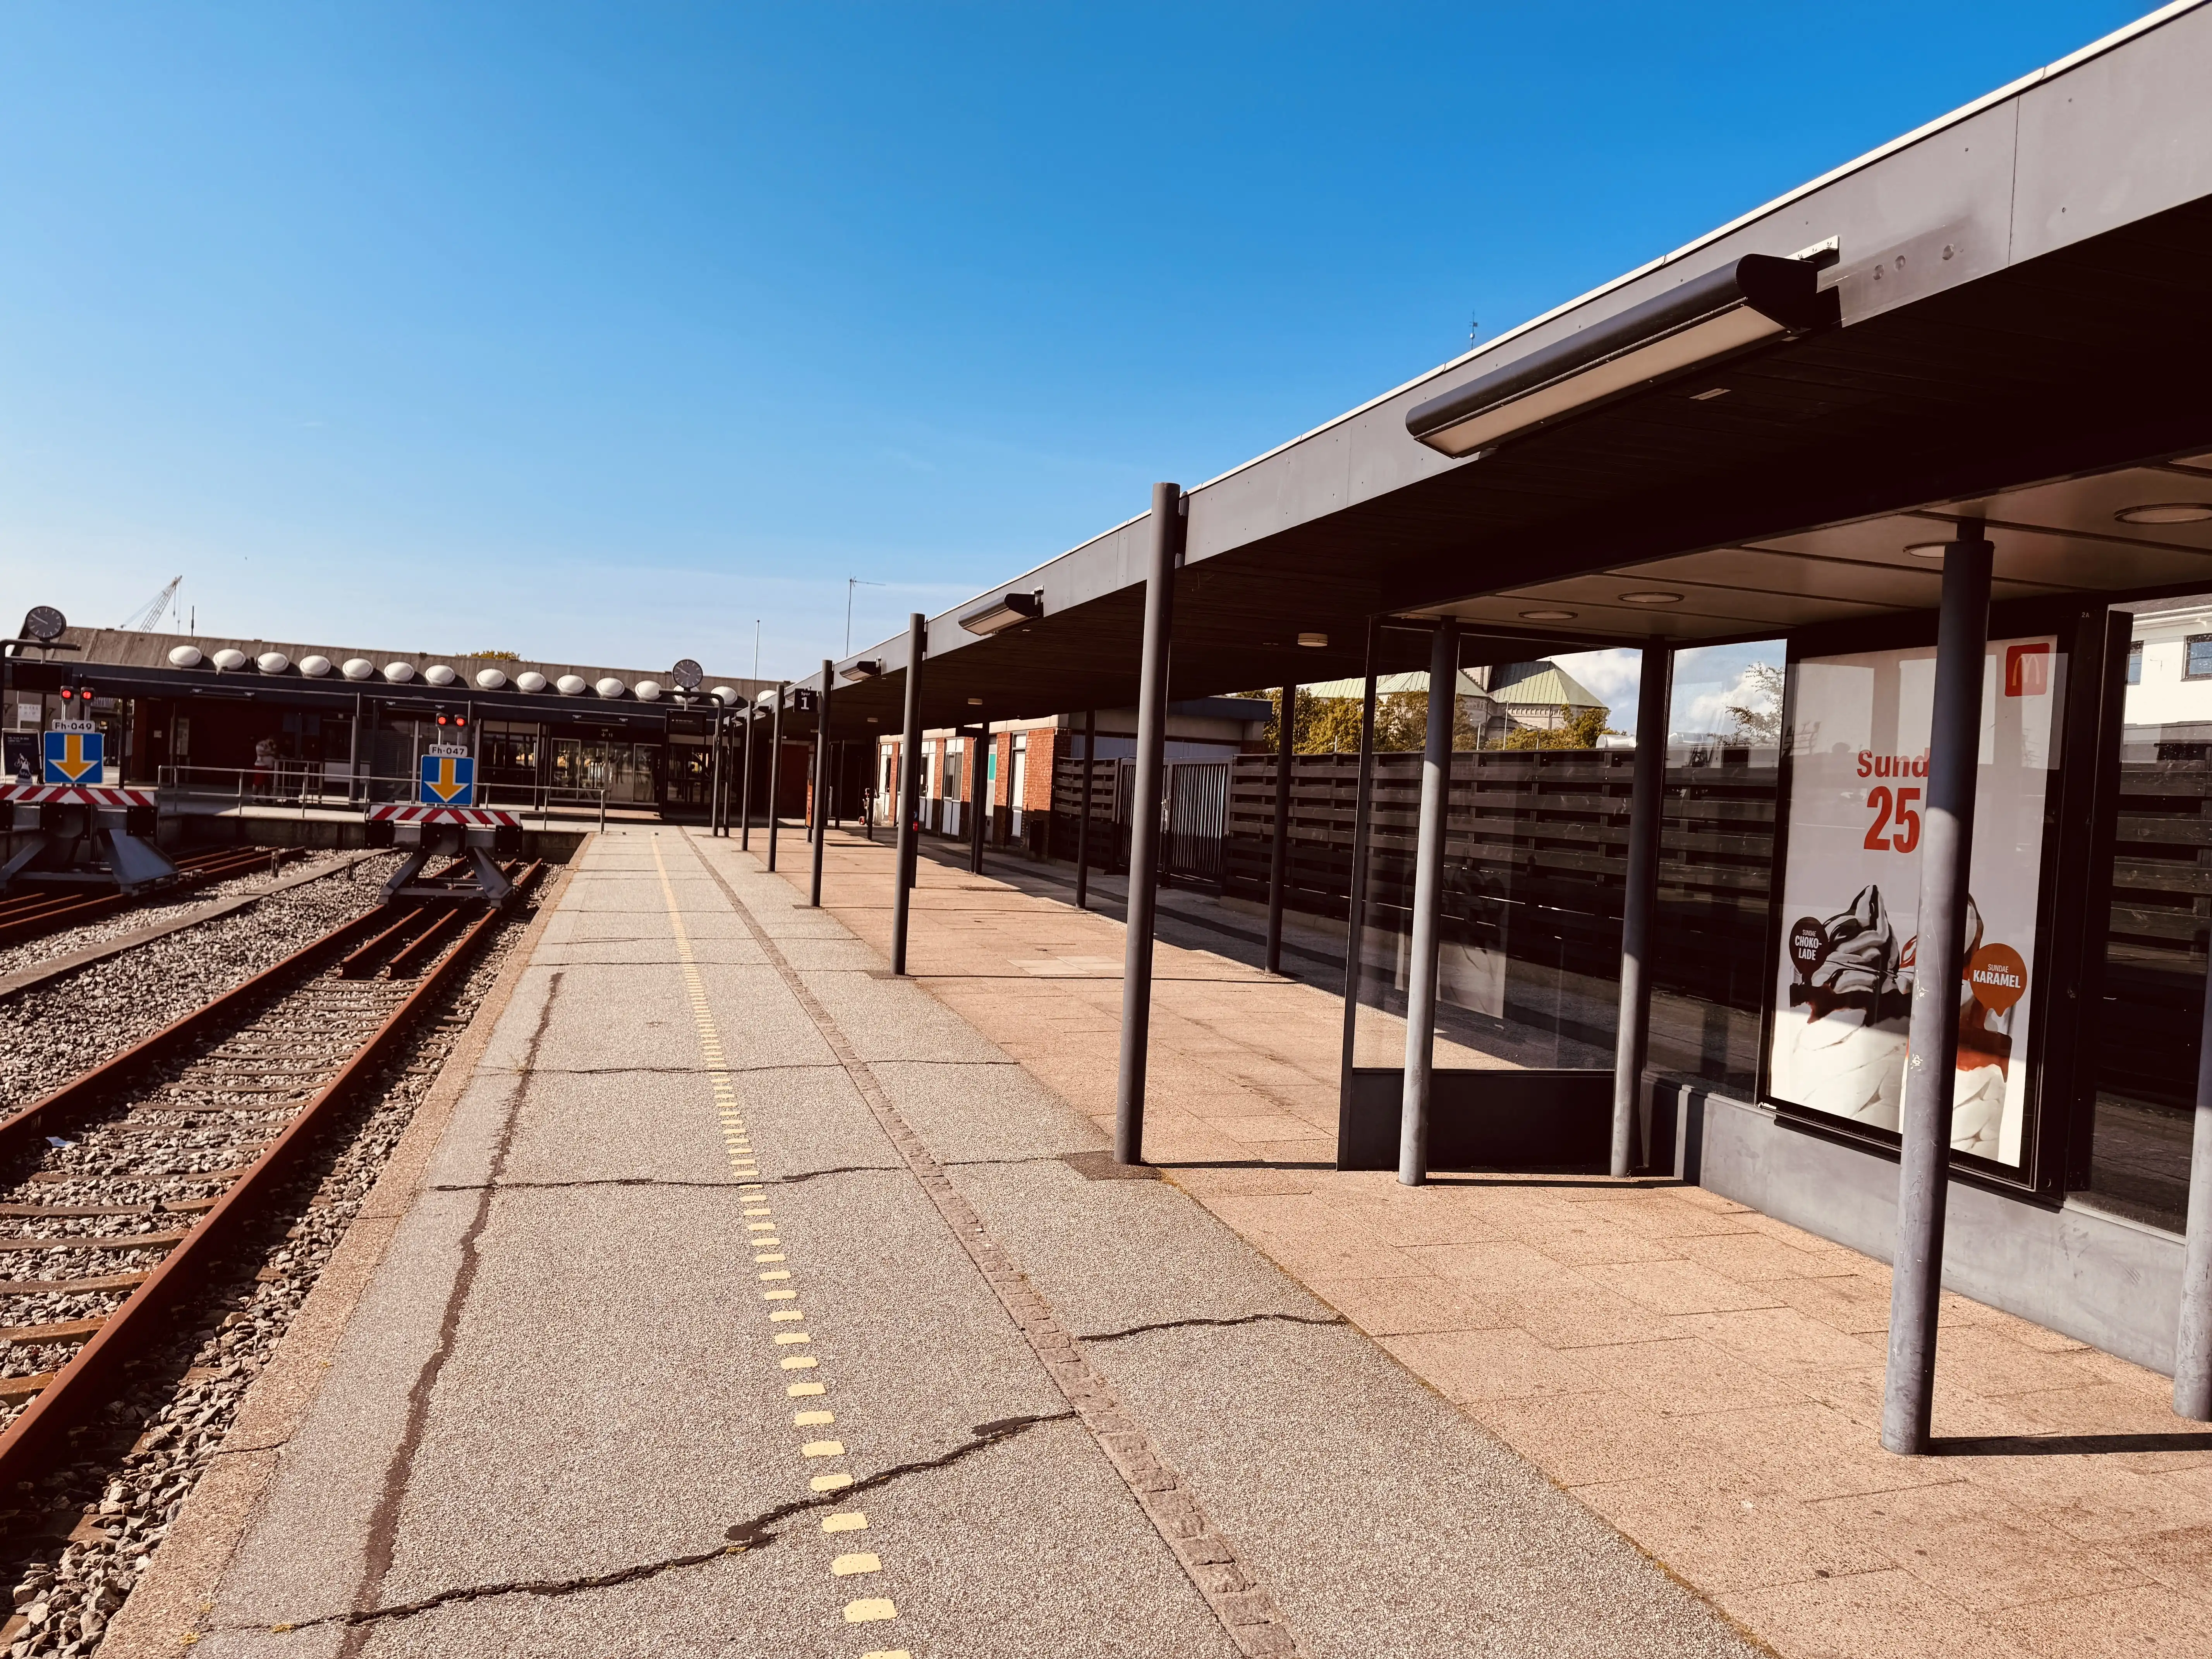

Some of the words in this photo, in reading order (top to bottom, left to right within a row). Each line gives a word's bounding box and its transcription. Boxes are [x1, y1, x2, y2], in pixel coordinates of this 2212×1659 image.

[801, 697, 809, 710] 1
[1857, 747, 1930, 778] Sund
[1864, 786, 1920, 854] 25
[1802, 929, 1817, 937] SUNDAE
[1795, 935, 1822, 949] CHOKO-
[1798, 947, 1817, 961] LADE
[1987, 963, 2009, 973] SUNDAE
[1973, 969, 2021, 988] KARAMEL
